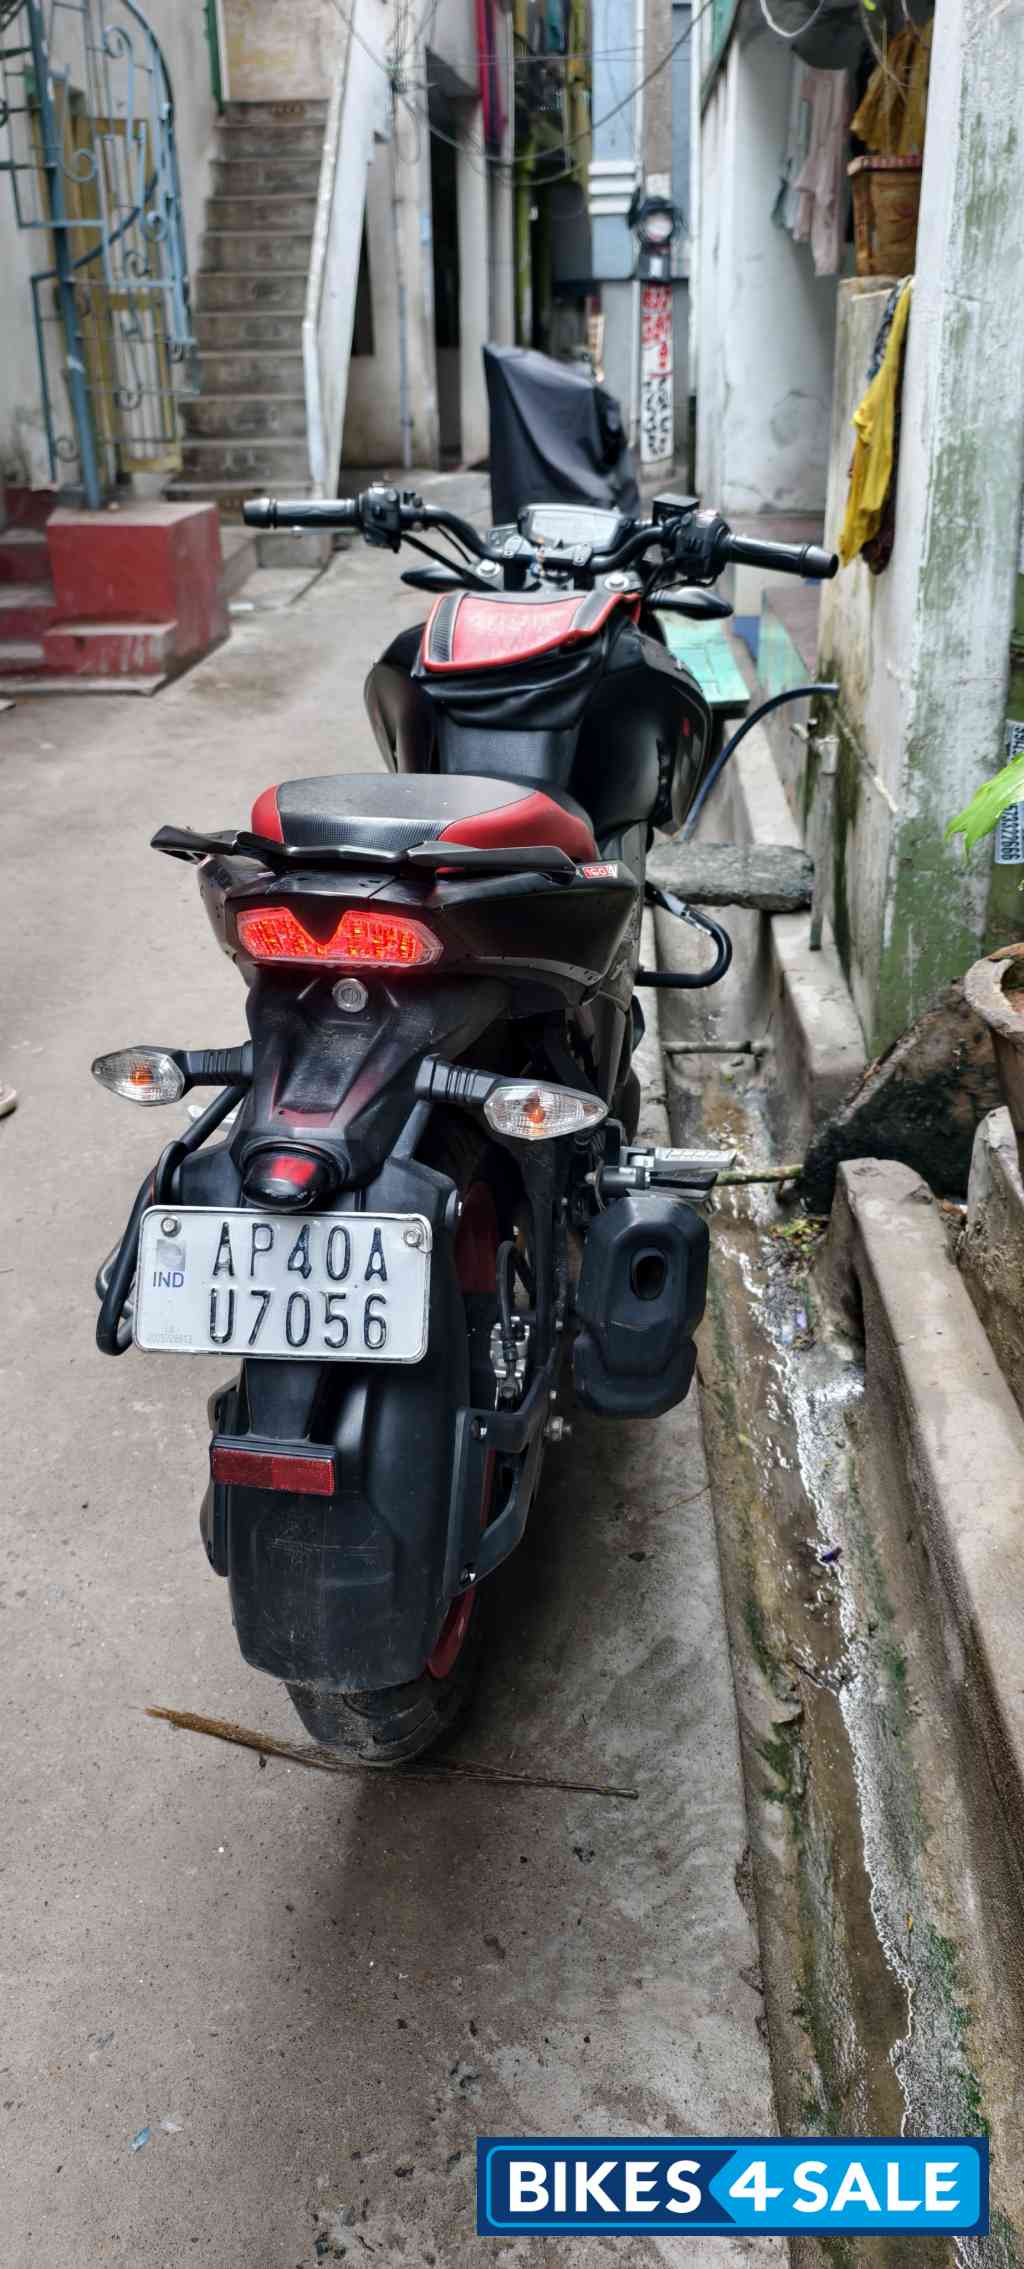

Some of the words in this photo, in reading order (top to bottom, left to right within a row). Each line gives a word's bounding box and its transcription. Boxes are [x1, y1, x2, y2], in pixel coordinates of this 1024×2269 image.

[152, 1271, 185, 1288] IND
[212, 1221, 387, 1283] AP40A
[209, 1288, 387, 1350] U7056
